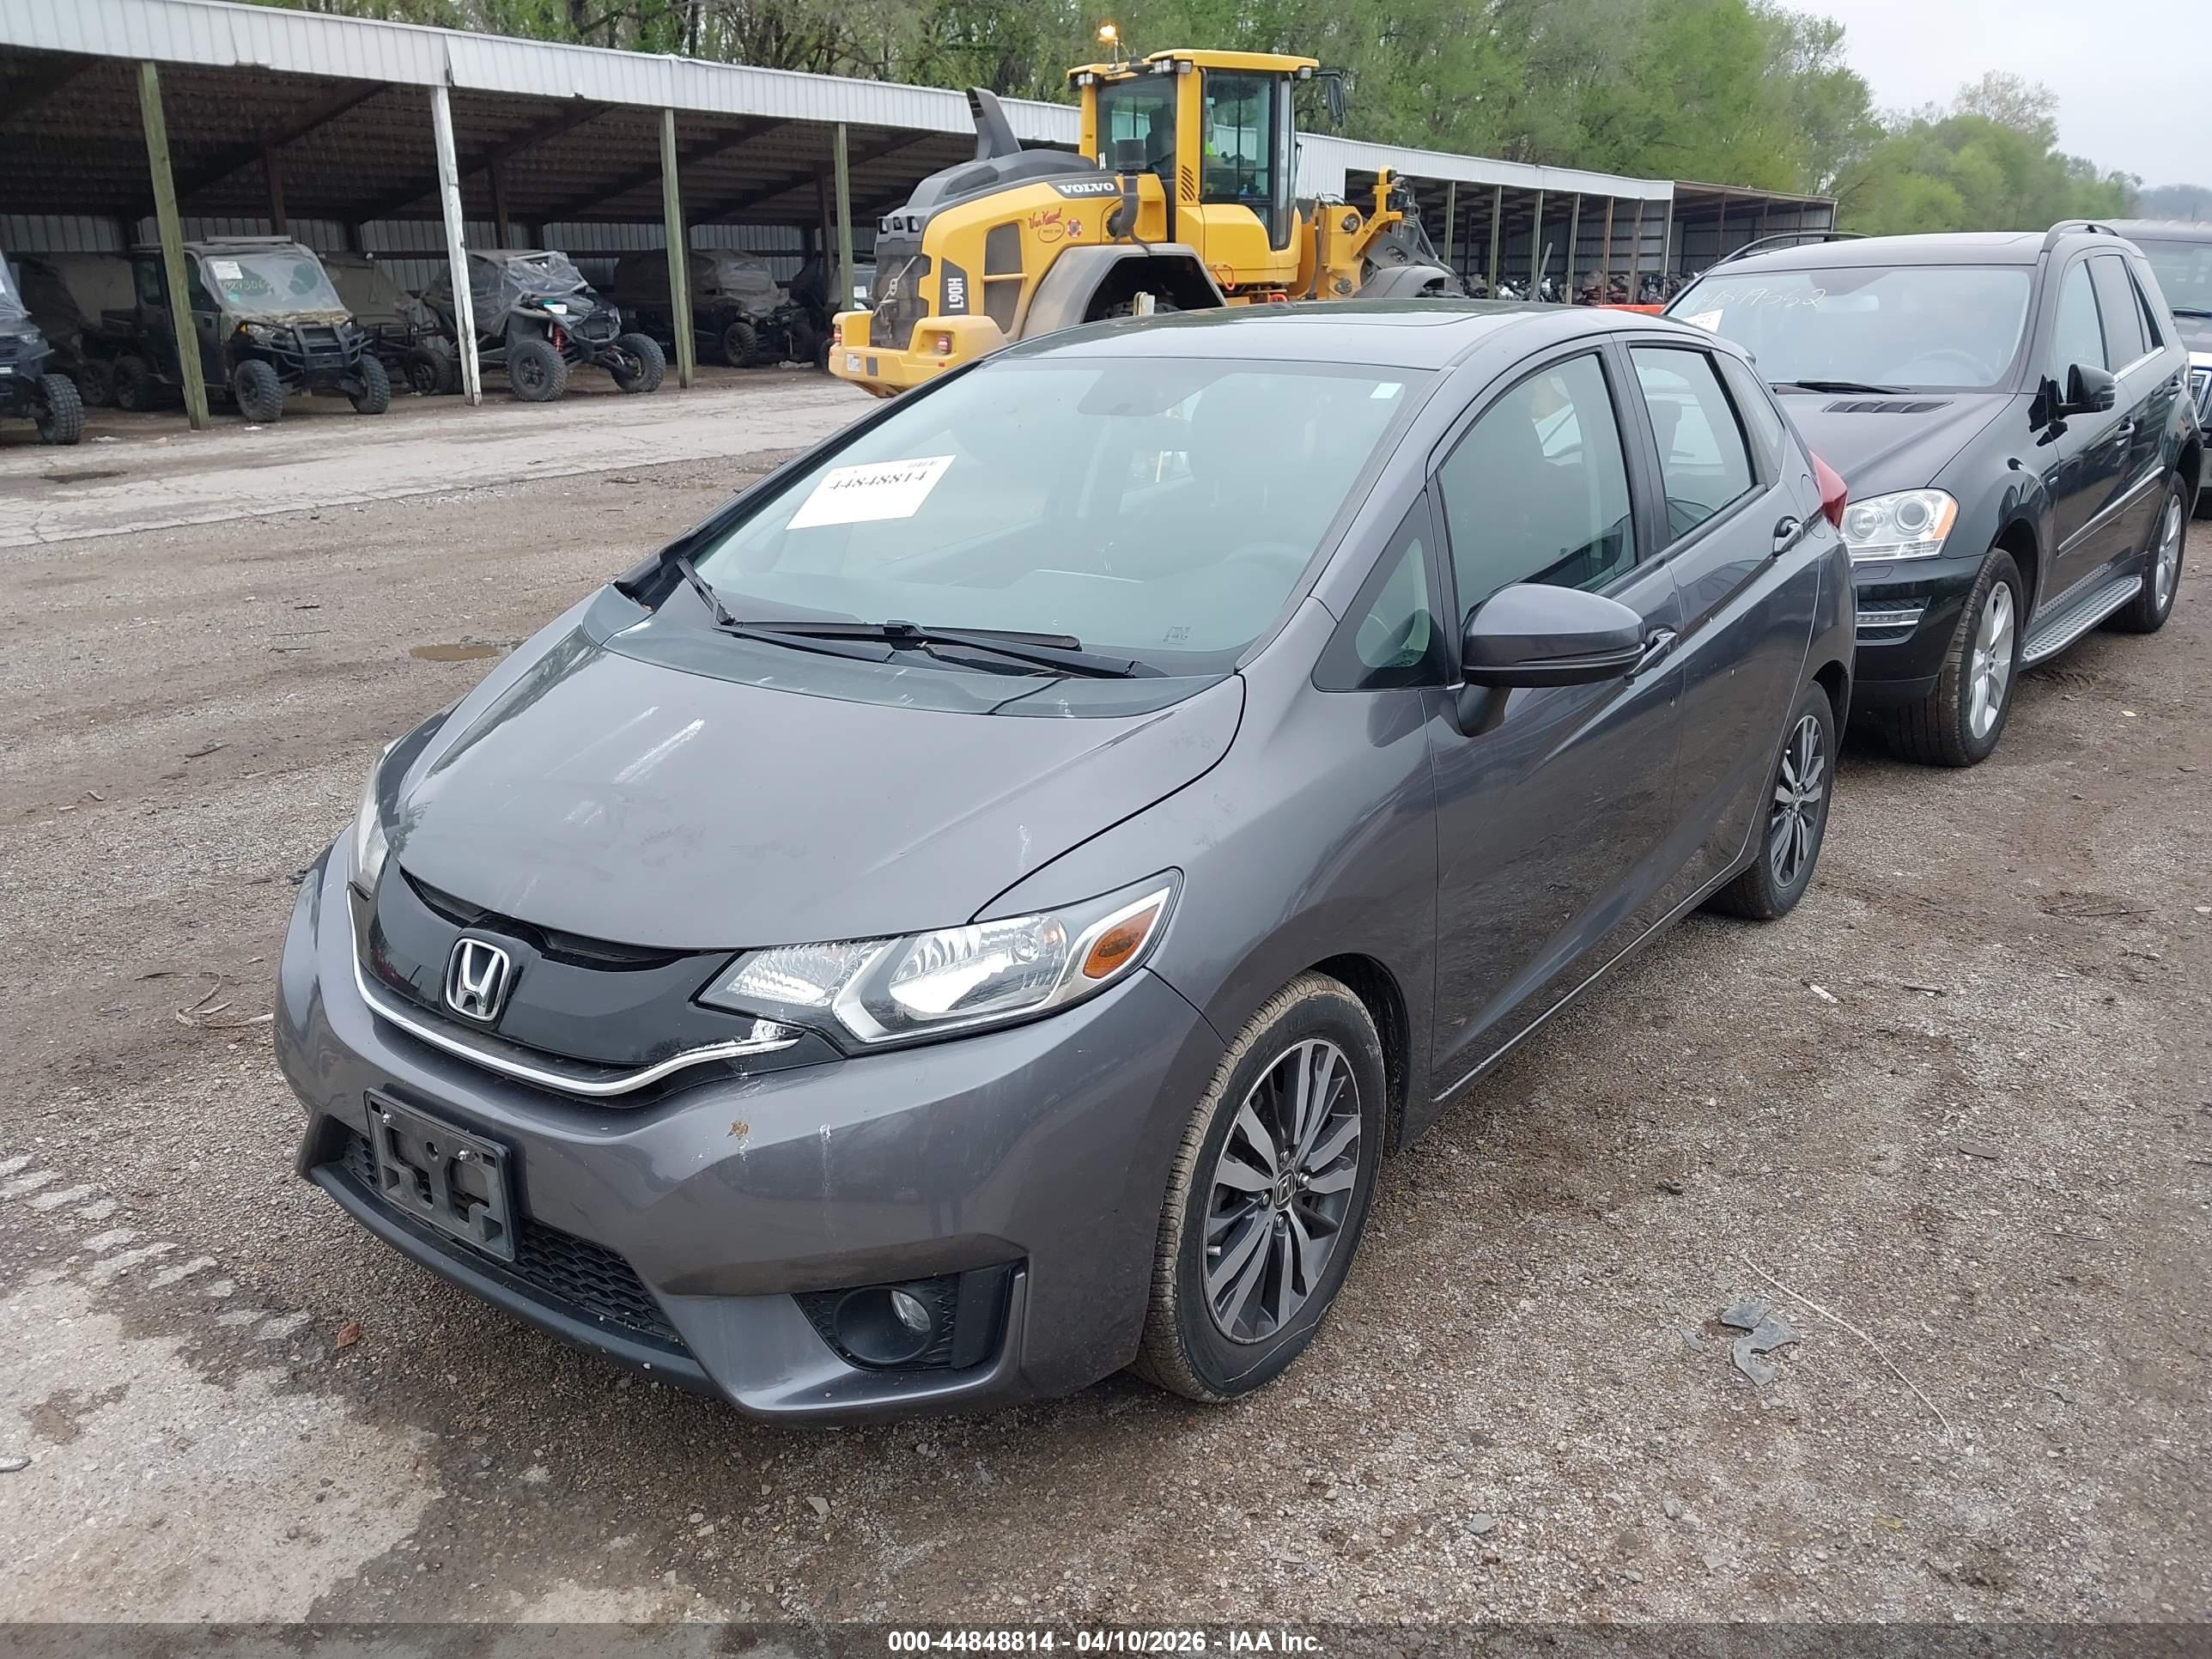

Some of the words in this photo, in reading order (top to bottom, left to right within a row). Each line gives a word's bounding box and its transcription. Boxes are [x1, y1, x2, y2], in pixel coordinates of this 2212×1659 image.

[1058, 182, 1115, 193] VOLVO
[947, 277, 964, 308] L90H
[829, 471, 927, 490] 44848814
